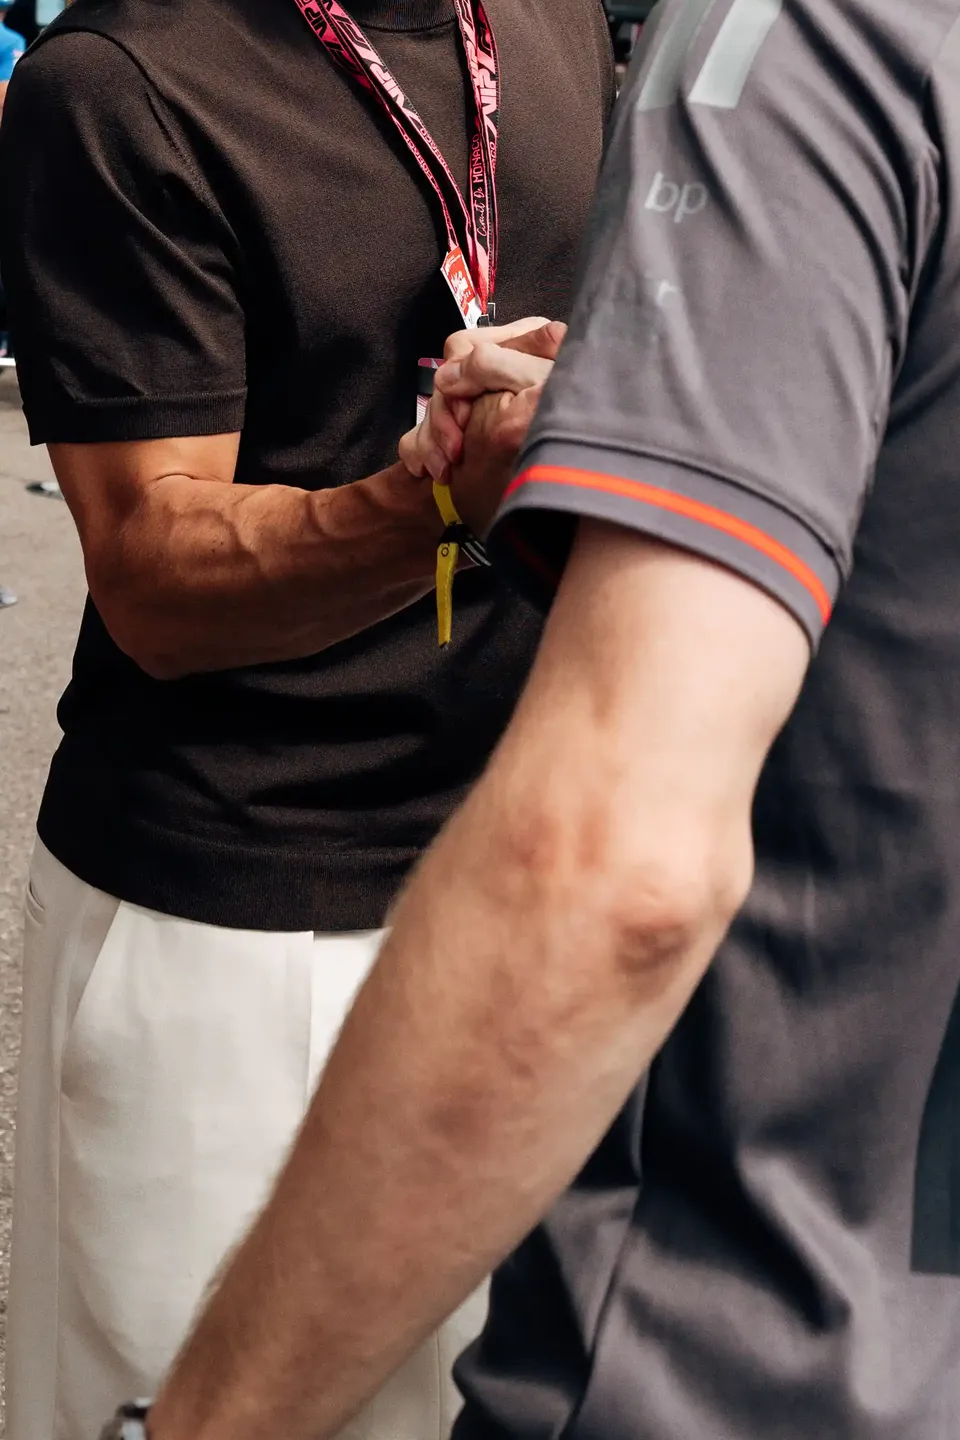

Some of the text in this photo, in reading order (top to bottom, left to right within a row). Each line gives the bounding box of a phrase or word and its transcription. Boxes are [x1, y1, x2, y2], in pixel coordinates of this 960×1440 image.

[302, 6, 328, 39] VIP
[370, 62, 411, 115] VIP
[478, 68, 498, 114] VIP
[471, 133, 484, 184] MONACO
[643, 171, 709, 224] bp
